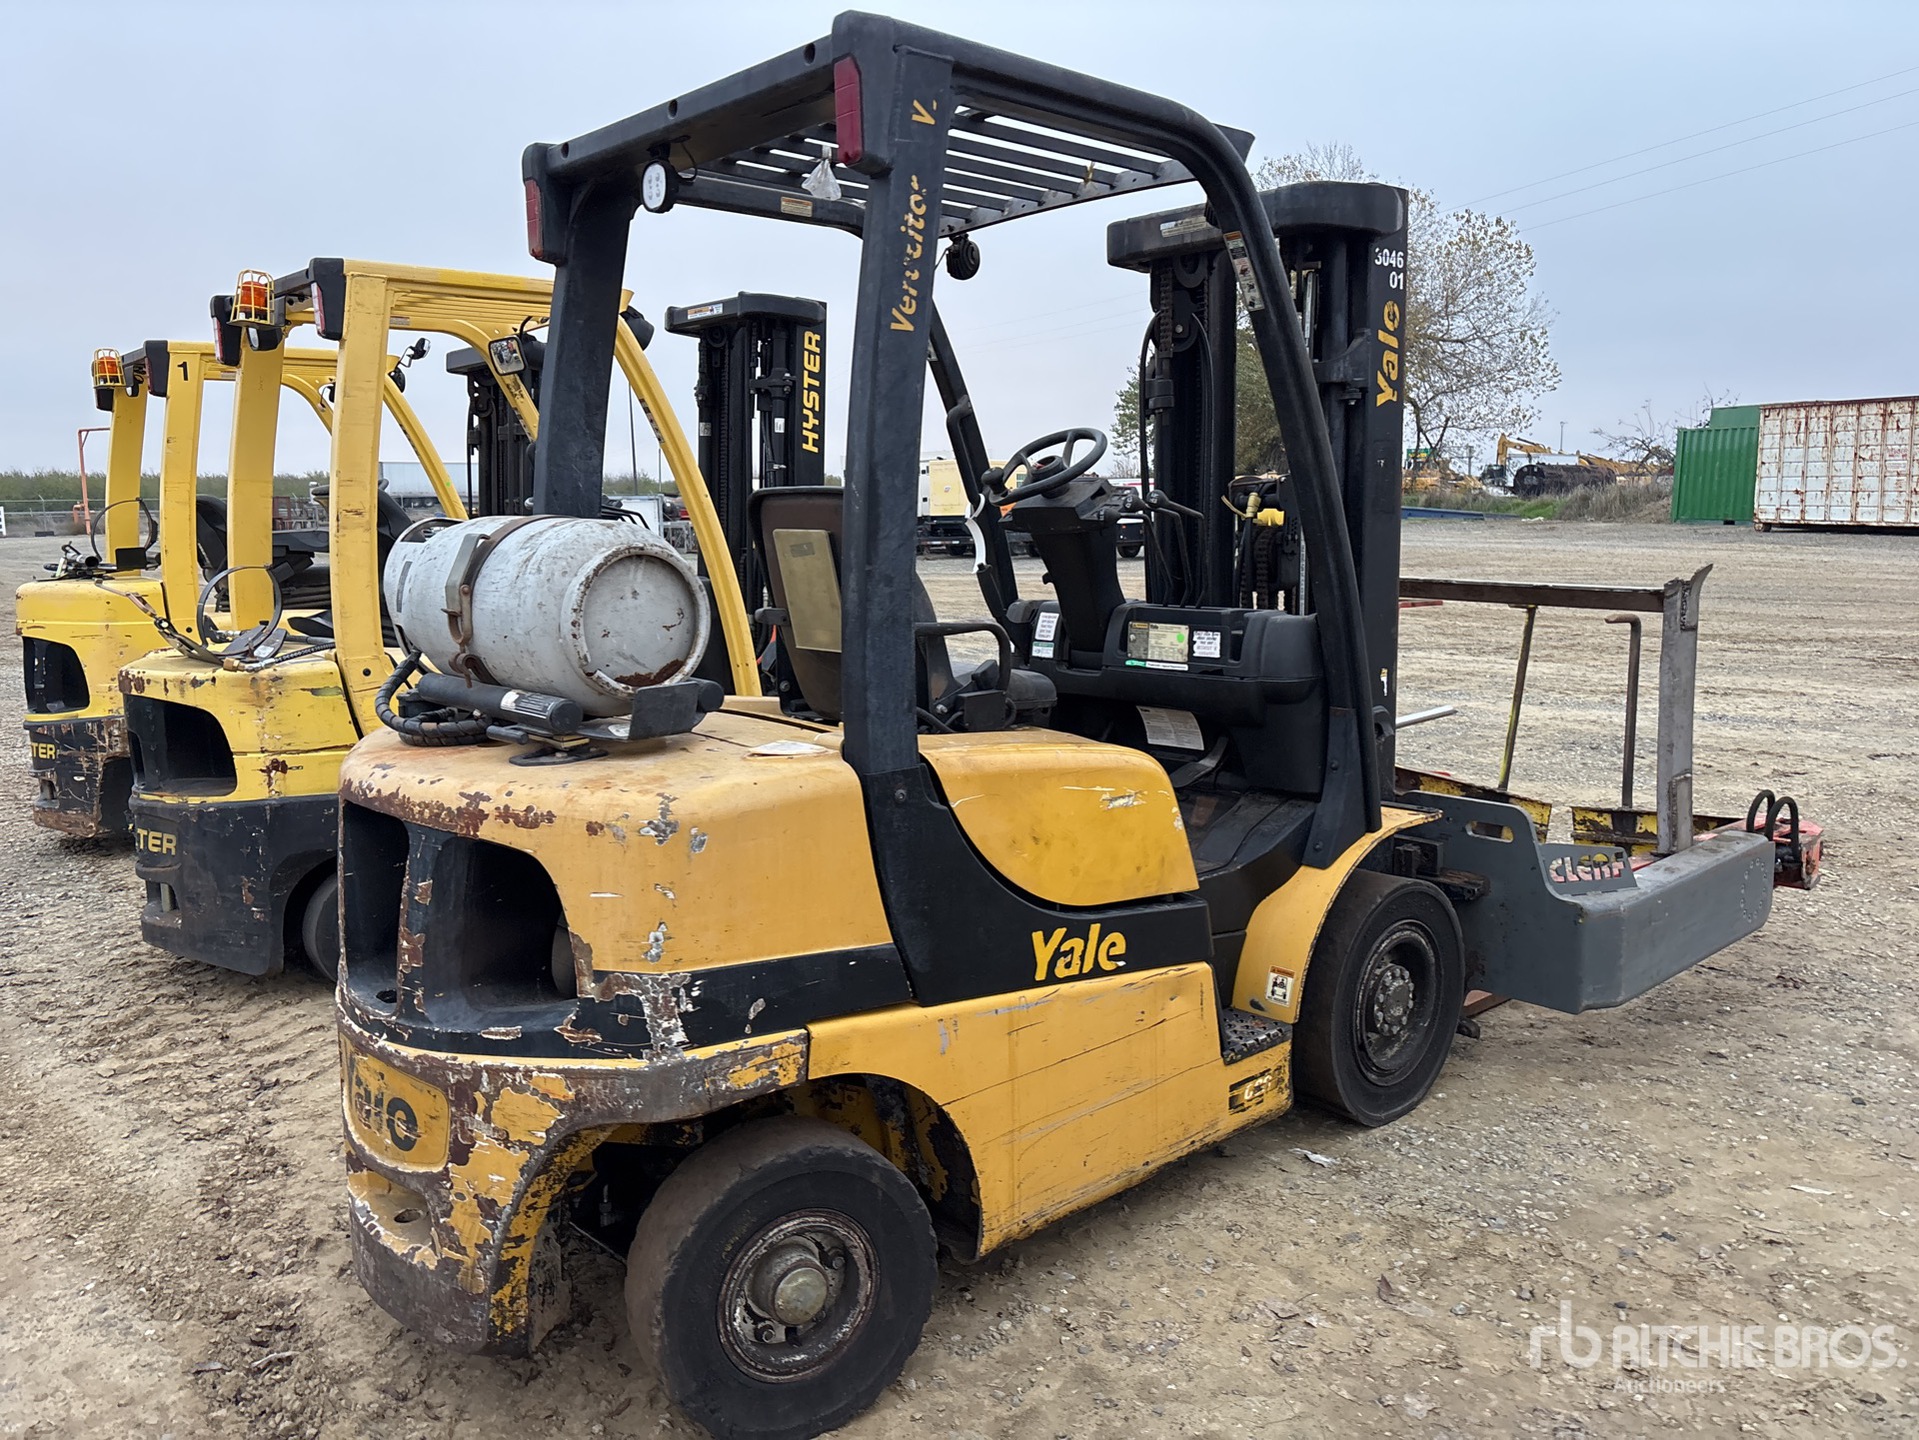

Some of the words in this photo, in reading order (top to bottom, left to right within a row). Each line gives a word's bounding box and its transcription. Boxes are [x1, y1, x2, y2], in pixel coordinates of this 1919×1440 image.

[1374, 247, 1404, 268] 3046
[1389, 271, 1404, 290] 01
[177, 361, 189, 381] 1
[1376, 300, 1400, 407] Yale
[802, 330, 821, 453] HYSTER
[1031, 922, 1127, 982] Yale
